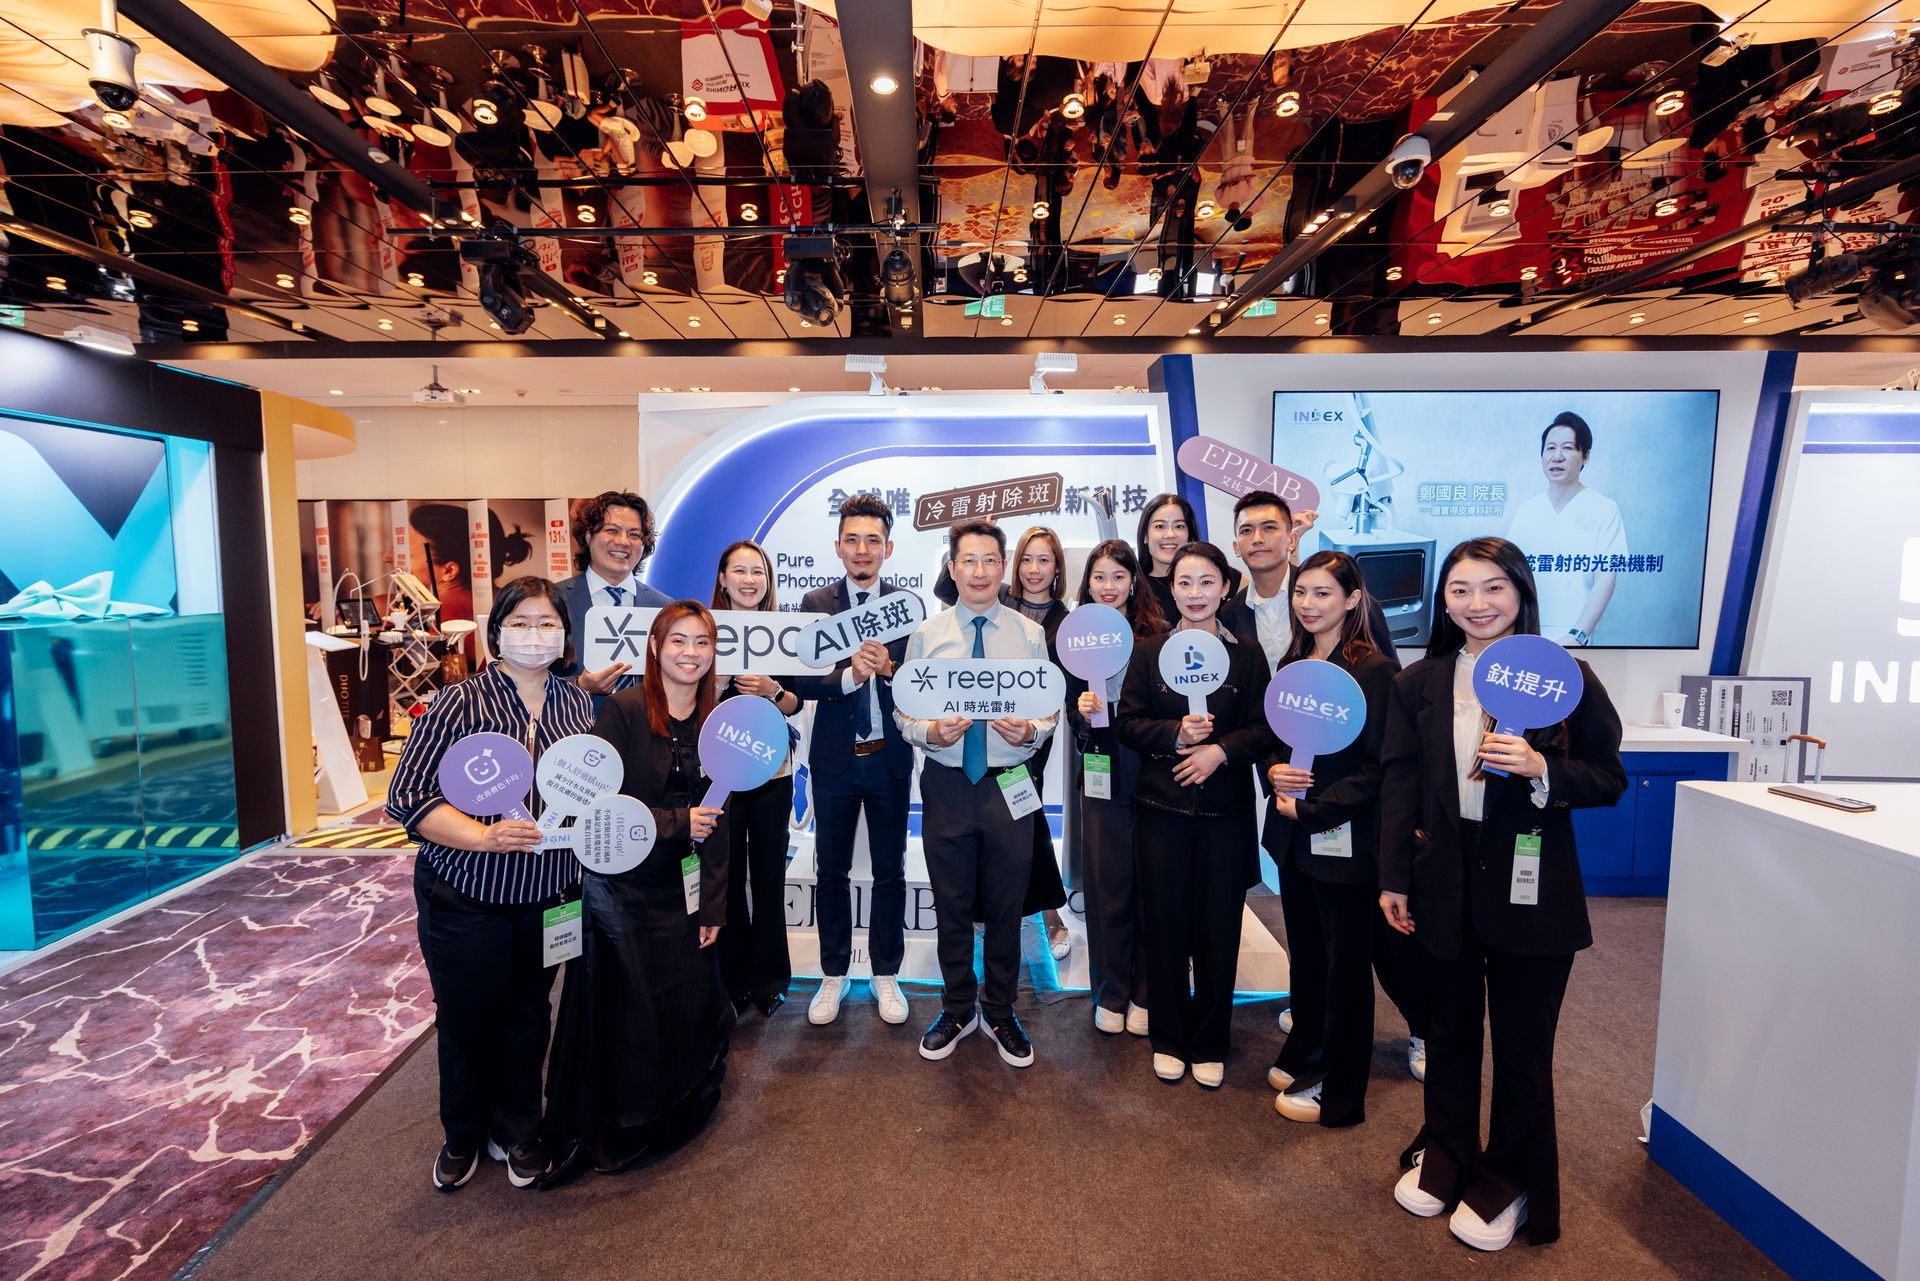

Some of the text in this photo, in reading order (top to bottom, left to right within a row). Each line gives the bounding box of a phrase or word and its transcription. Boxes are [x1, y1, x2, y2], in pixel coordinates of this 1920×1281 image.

[1293, 409, 1343, 422] INDEX
[1200, 443, 1302, 501] EPILAB
[925, 484, 1050, 521] 冷雷射除斑
[1419, 484, 1505, 501] 鄭國良 院長
[777, 552, 815, 568] Pure
[777, 573, 923, 588] Photomnical
[1067, 631, 1123, 649] INDEX
[948, 666, 1047, 696] reepot
[1174, 672, 1220, 685] INDEX
[1485, 662, 1568, 703] 鈦提升
[943, 700, 1016, 713] AI 時光雷射
[1278, 691, 1351, 721] INDEX
[1697, 687, 1707, 726] Meeting
[717, 722, 777, 761] INDEX
